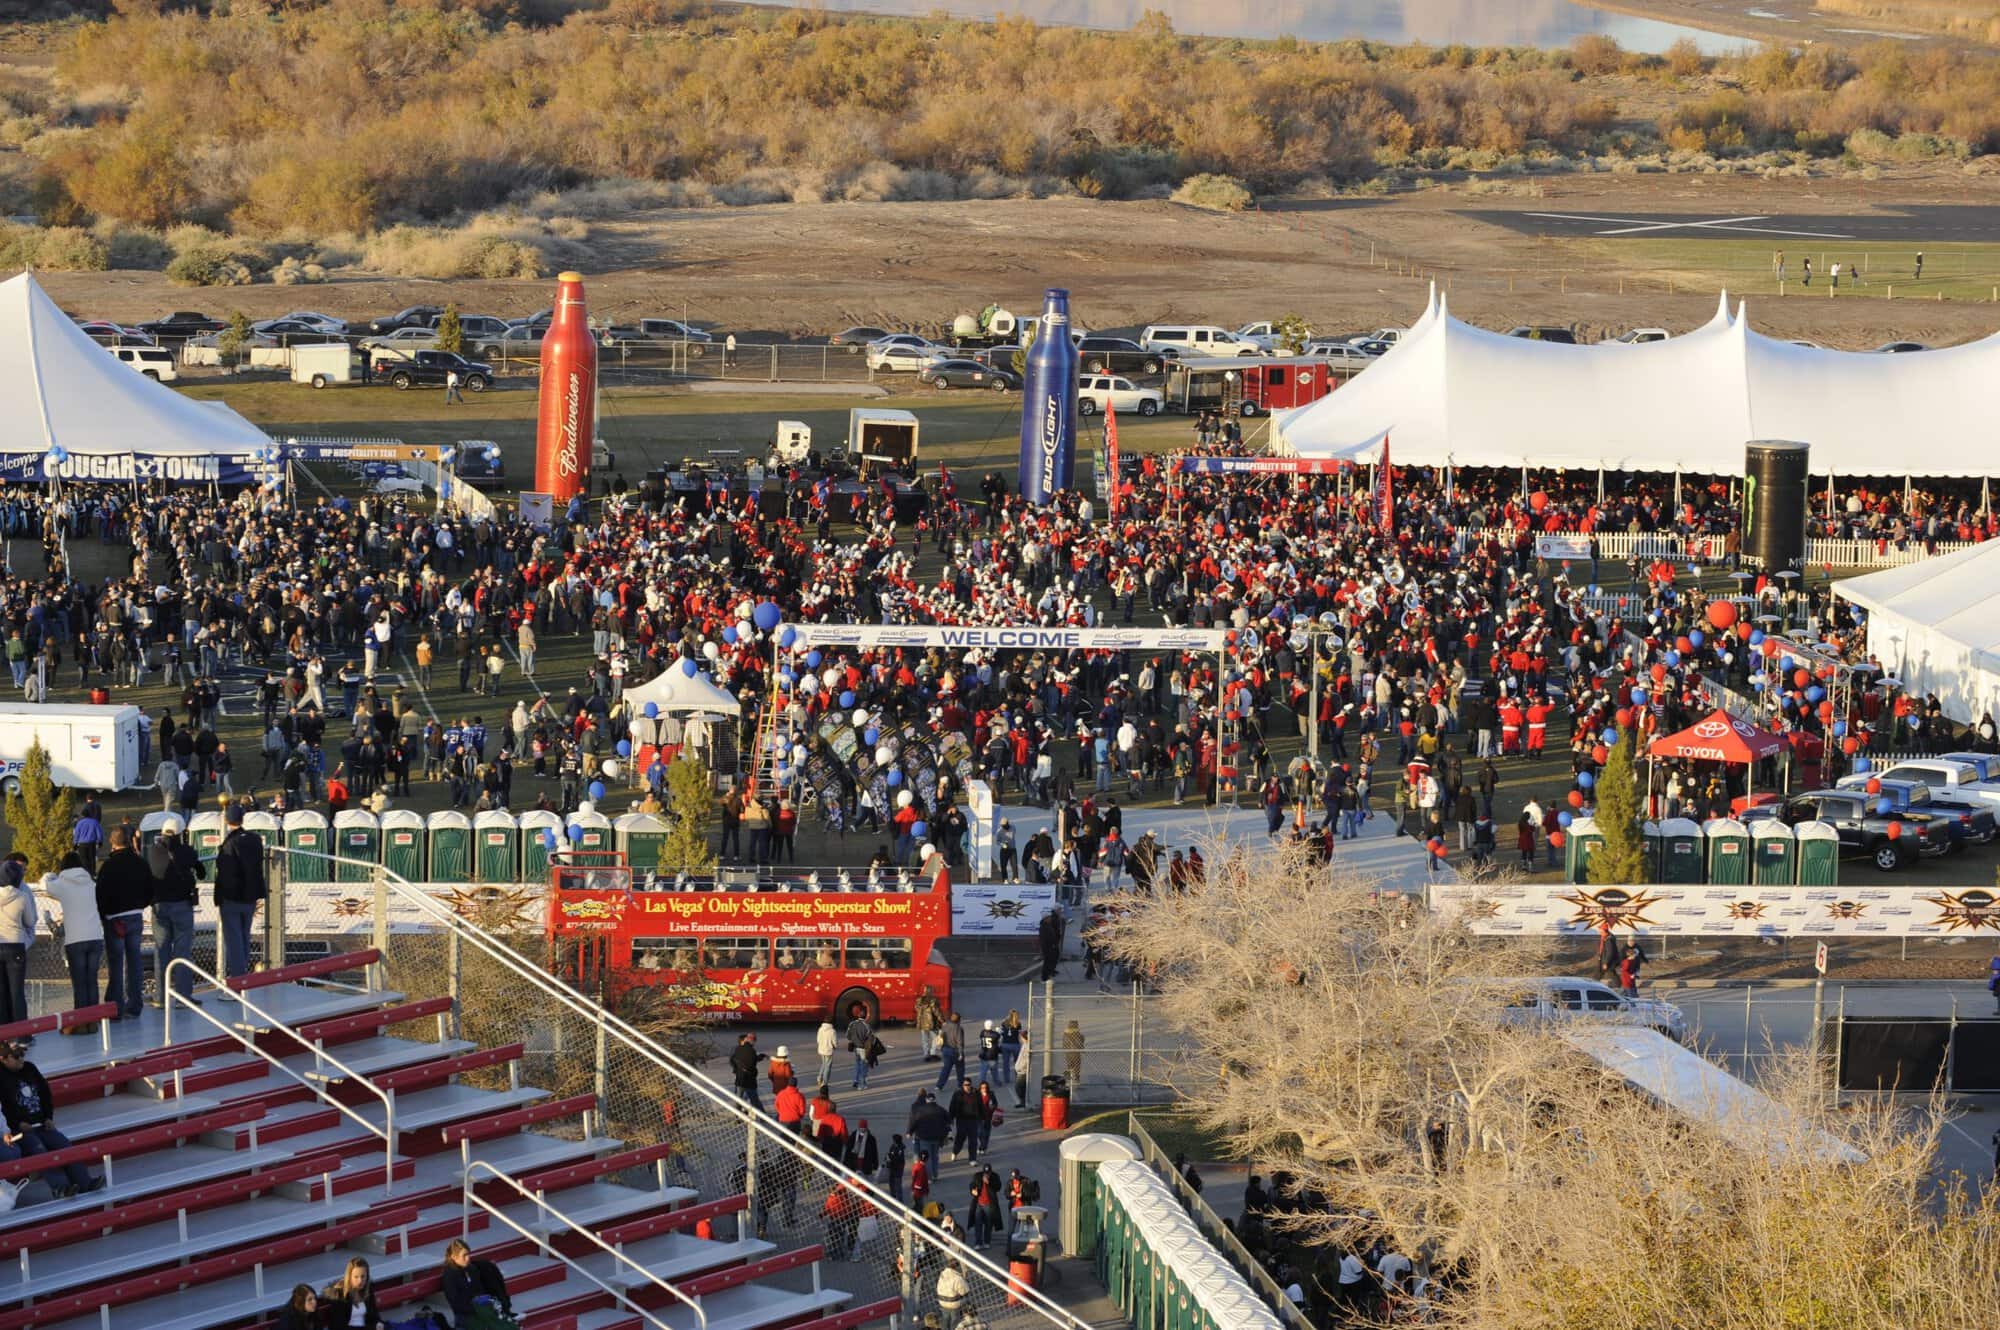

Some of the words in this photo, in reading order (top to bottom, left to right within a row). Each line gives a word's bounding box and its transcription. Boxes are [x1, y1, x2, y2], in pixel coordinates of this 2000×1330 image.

[560, 373, 579, 476] Budweiser
[1046, 395, 1056, 447] LIGHT
[23, 463, 35, 478] to
[43, 455, 135, 480] COUGAR
[153, 457, 220, 480] TOWN
[1043, 456, 1053, 493] BUD
[1221, 461, 1234, 470] VIP
[1235, 461, 1279, 471] HOSPITALITY
[941, 631, 1080, 647] WELCOME
[1676, 746, 1725, 759] TOYOTA
[645, 898, 667, 912] Las
[708, 897, 740, 917] Only
[742, 897, 812, 918] Sightseeing
[814, 898, 872, 918] Superstar
[873, 898, 911, 914] Show!
[669, 922, 690, 932] Live
[691, 922, 758, 932] Entertainment
[818, 922, 842, 932] With
[843, 922, 861, 932] The
[862, 922, 885, 932] Stars
[1818, 946, 1825, 969] 6
[982, 1037, 993, 1049] 15
